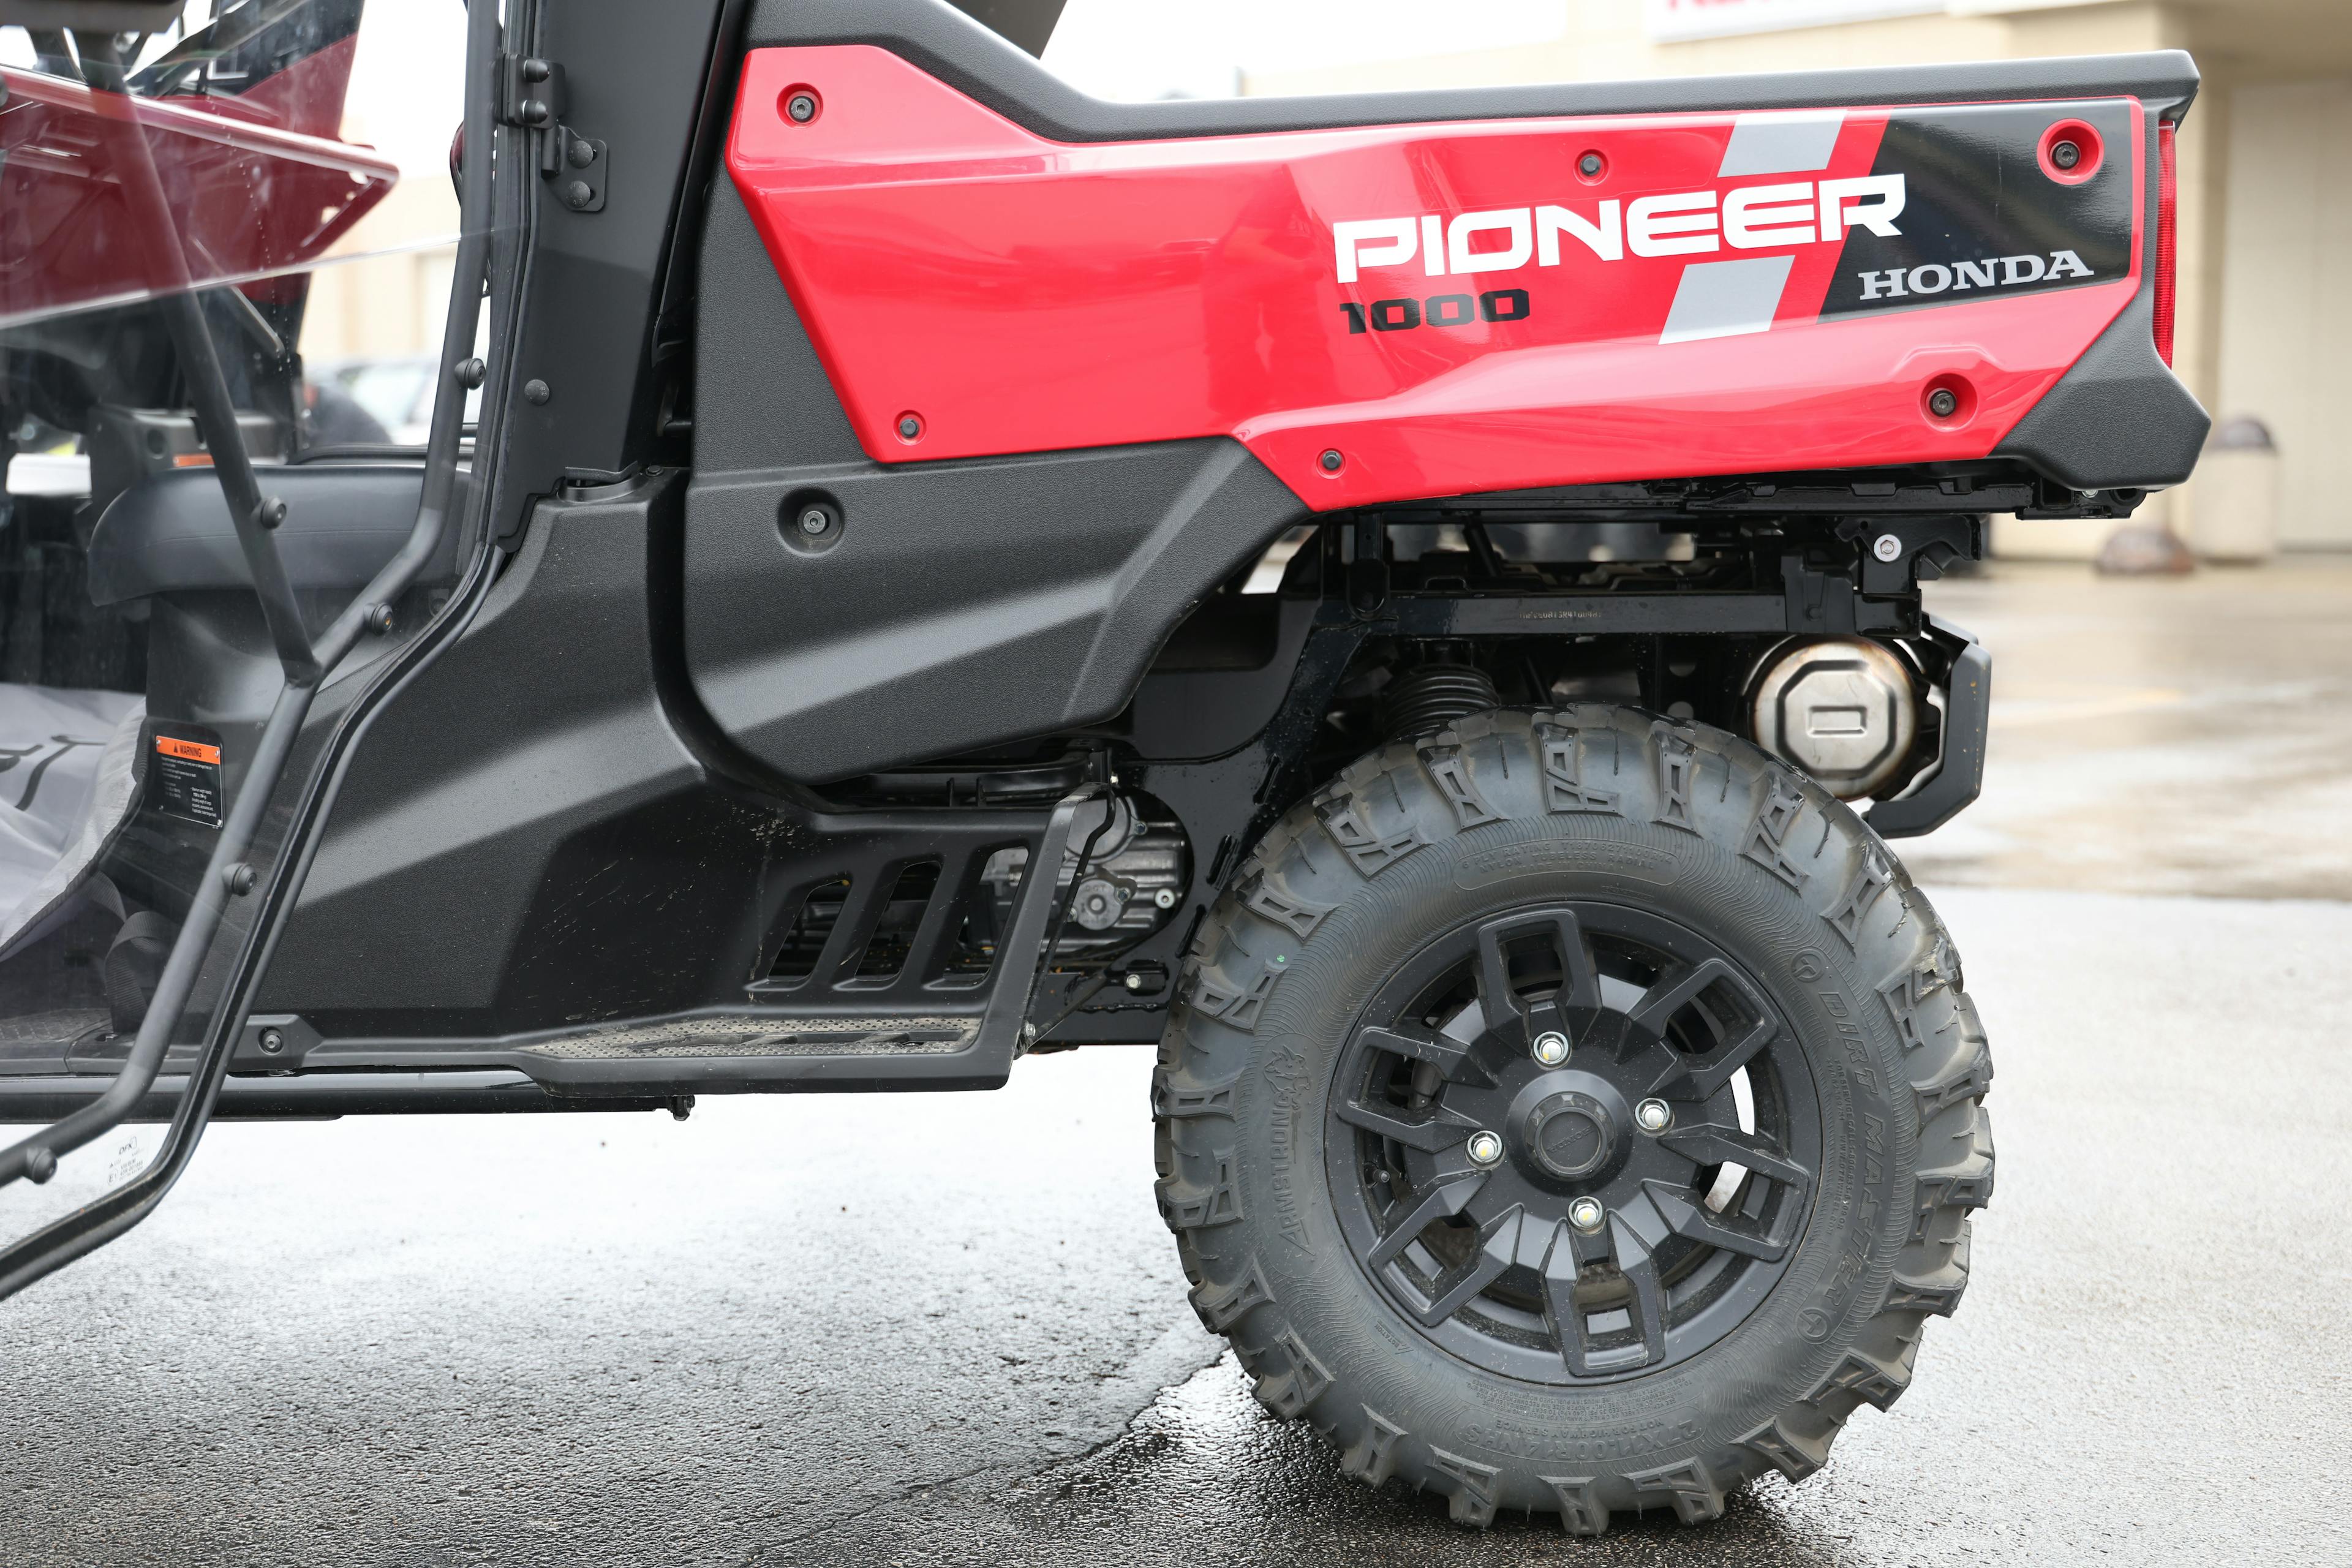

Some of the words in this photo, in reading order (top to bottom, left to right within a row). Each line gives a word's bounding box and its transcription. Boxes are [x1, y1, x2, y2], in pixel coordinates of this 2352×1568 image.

[1333, 173, 1906, 283] PIONEER
[1859, 250, 2094, 300] HONDA
[1340, 288, 1531, 334] 1000
[179, 745, 202, 758] WARNING
[1472, 850, 1499, 866] PLY
[1502, 840, 1551, 858] RATING
[1531, 850, 1597, 862] TUBELESS
[1607, 851, 1656, 870] RADIAL
[1818, 990, 1877, 1096] DIRT
[1838, 1076, 1855, 1118] SERVICE
[1845, 1119, 1856, 1143] CALL
[1270, 1090, 1316, 1257] ARMSTRONG
[1828, 1112, 1884, 1308] MASTER
[1494, 1419, 1548, 1438] SERVICE
[1637, 1416, 1664, 1432] NOT
